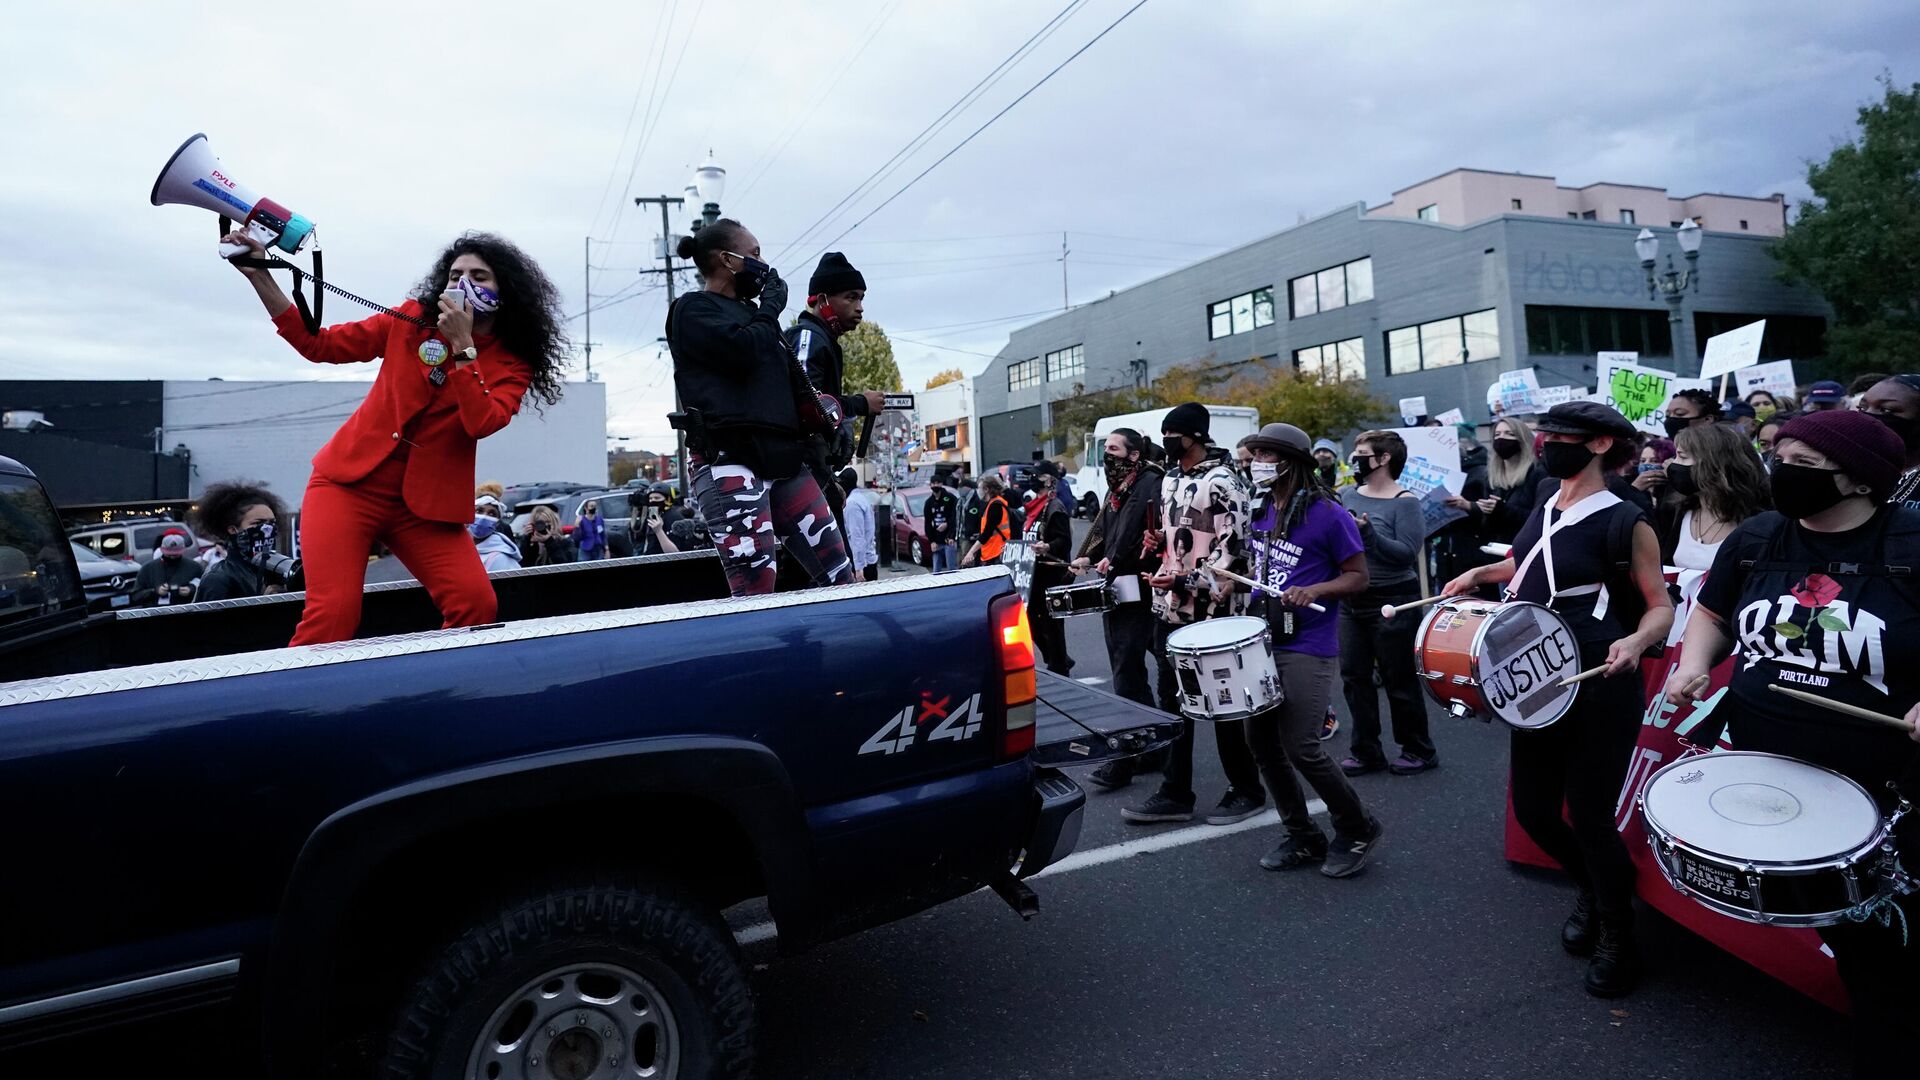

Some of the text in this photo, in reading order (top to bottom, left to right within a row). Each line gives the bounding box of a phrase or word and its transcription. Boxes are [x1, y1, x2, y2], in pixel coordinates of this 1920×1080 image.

[212, 170, 237, 189] PYLE
[1540, 387, 1570, 396] OUNT
[1609, 367, 1673, 397] FIGHT
[1624, 390, 1646, 403] THE
[1606, 396, 1664, 426] POWER
[1428, 428, 1457, 449] BLM
[1268, 568, 1287, 585] 20
[1731, 595, 1888, 696] BLM
[1483, 627, 1575, 710] JUSTICE
[1778, 669, 1829, 687] PORTLAND
[1179, 658, 1199, 707] YAHA
[1682, 855, 1736, 880] THIS MACHINE
[1686, 863, 1735, 888] KILLS
[1686, 872, 1751, 900] FASCISTS
